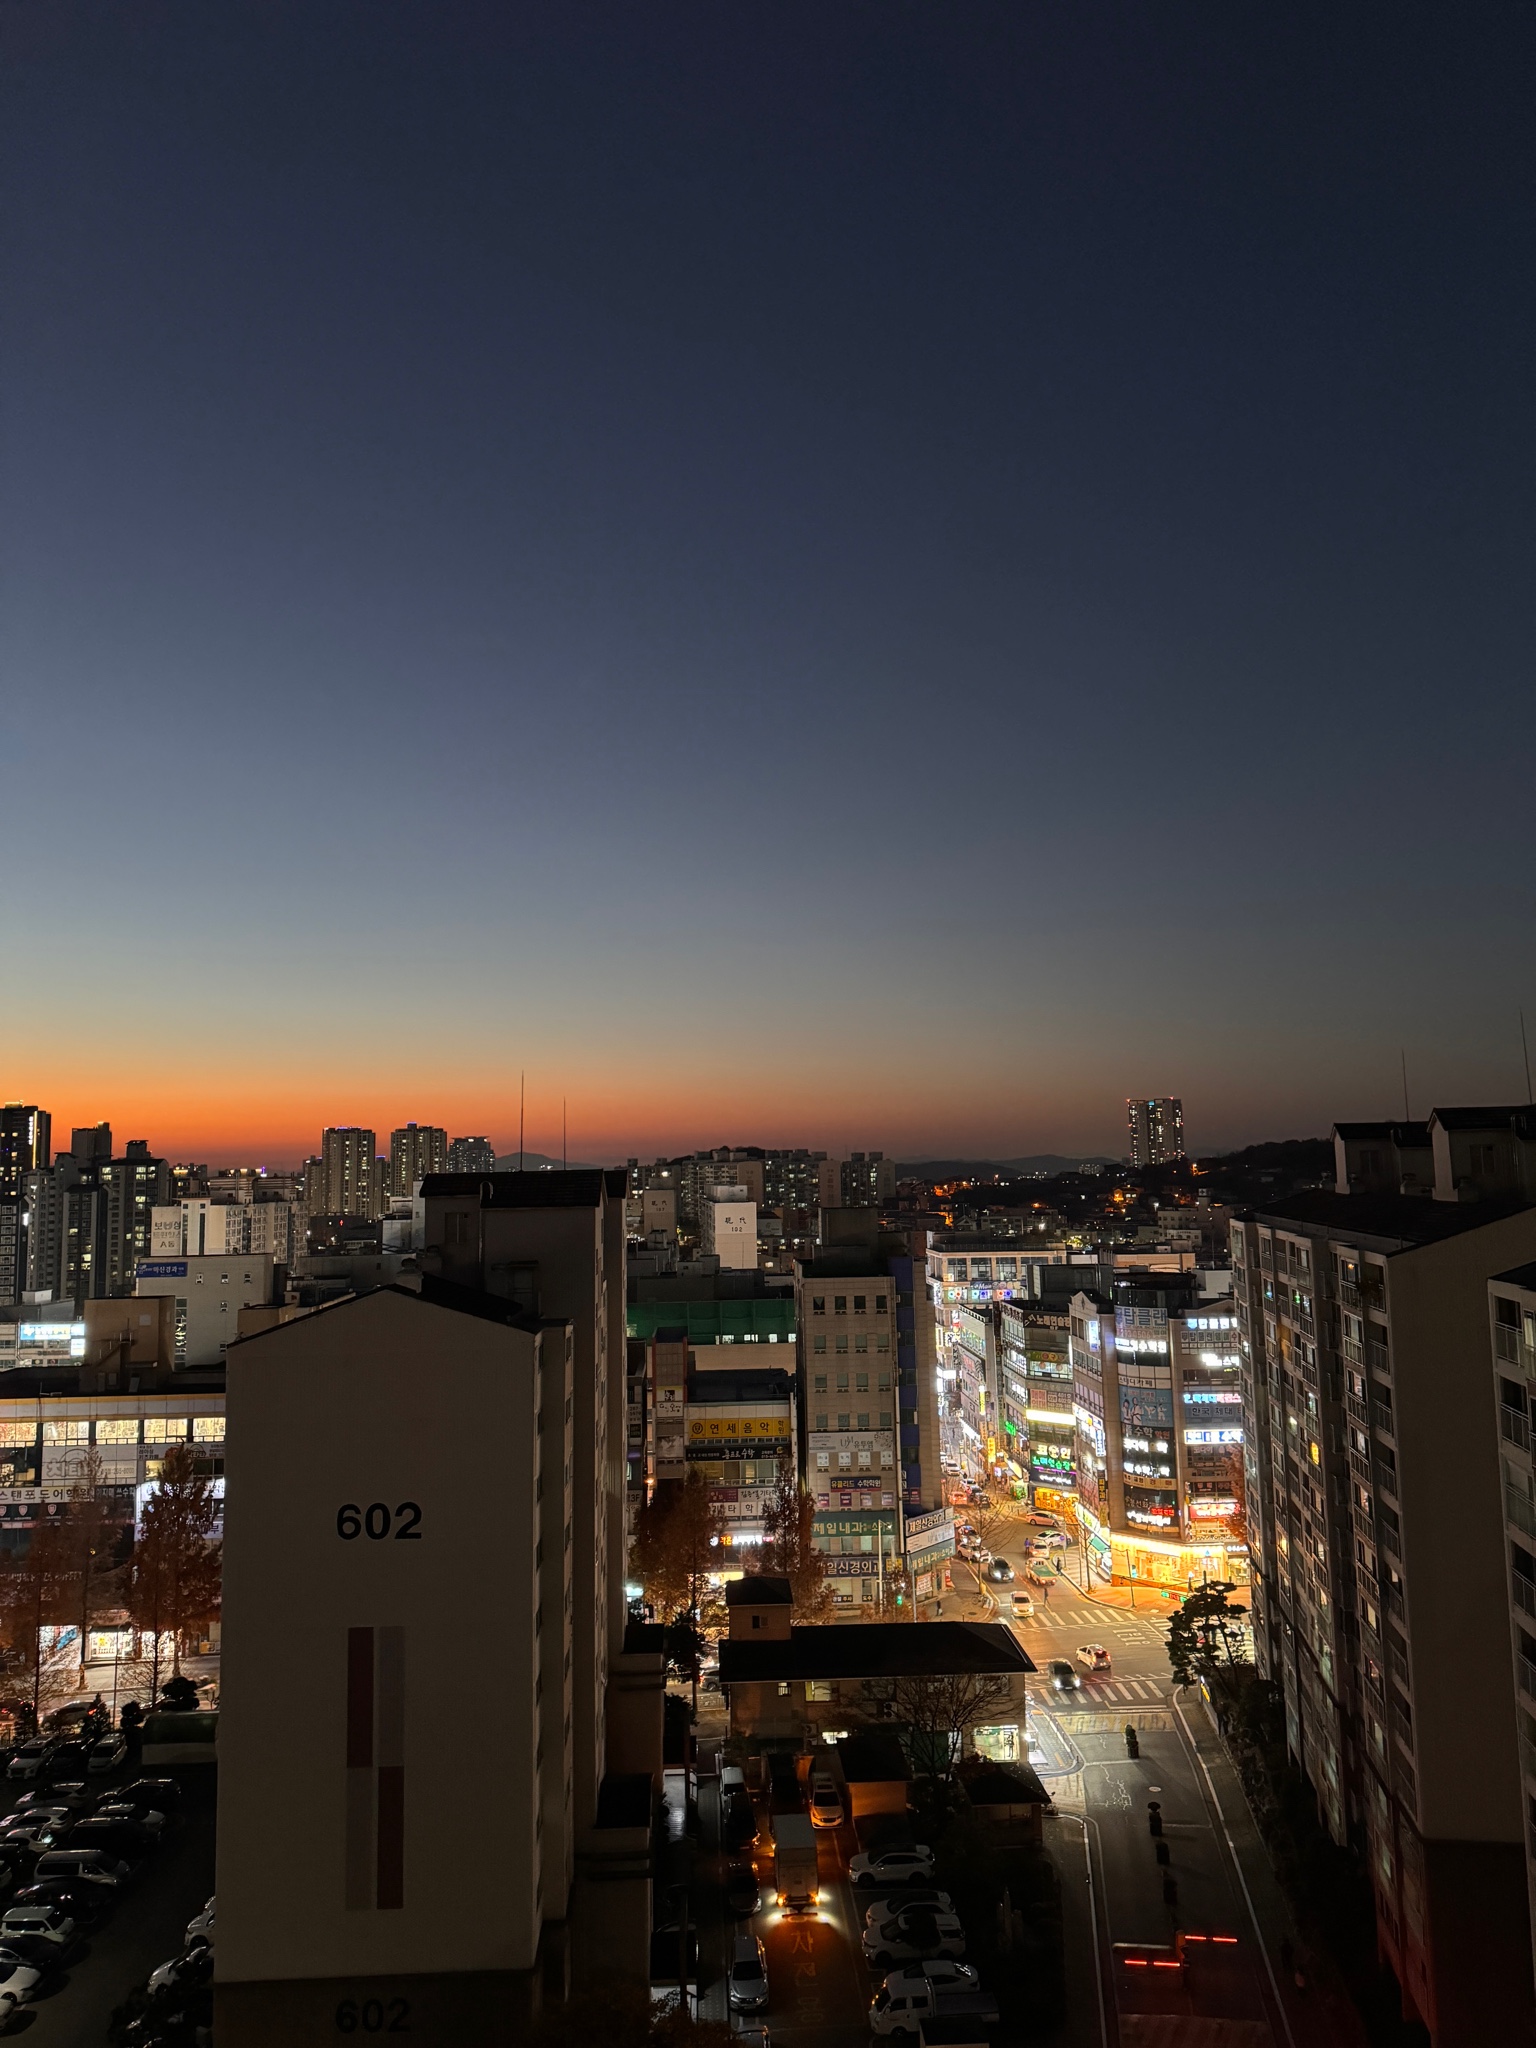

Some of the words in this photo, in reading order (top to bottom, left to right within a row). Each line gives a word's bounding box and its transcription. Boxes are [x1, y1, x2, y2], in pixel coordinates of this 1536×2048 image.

[709, 1423, 770, 1434] 연세음악
[1133, 1426, 1153, 1438] 수학
[741, 1448, 755, 1459] 수학
[857, 1479, 881, 1488] 수학학원
[0, 1488, 90, 1503] 스탠포드어학원
[337, 1501, 422, 1540] 602
[909, 1512, 945, 1533] 제일신경외과
[813, 1522, 863, 1534] 제일내과
[336, 1998, 411, 2033] 602
